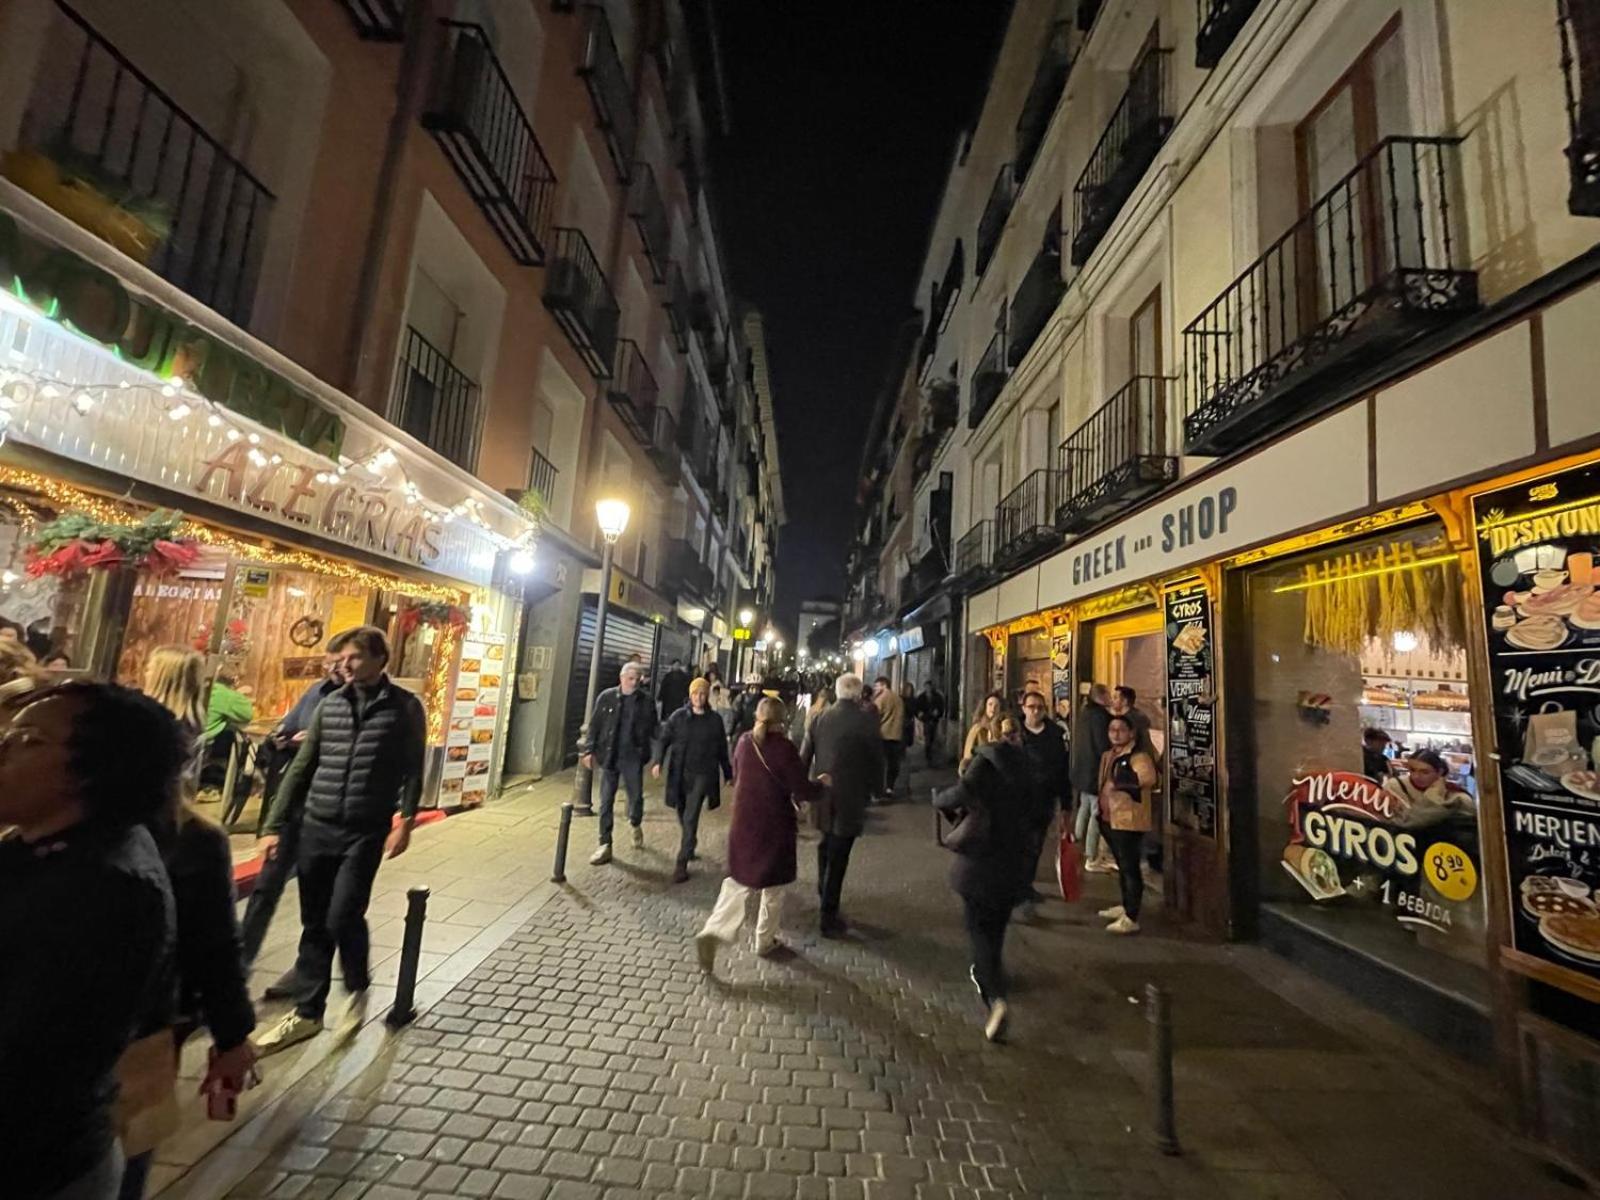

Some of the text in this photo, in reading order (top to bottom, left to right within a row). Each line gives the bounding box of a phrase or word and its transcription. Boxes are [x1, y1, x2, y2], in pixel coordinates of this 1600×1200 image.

[1072, 535, 1126, 586] GREEK
[1162, 487, 1237, 553] SHOP
[1491, 504, 1600, 557] DESAYUN
[1305, 811, 1418, 875] GYROS
[1380, 879, 1391, 904] 1
[1397, 890, 1452, 926] BEBIDA
